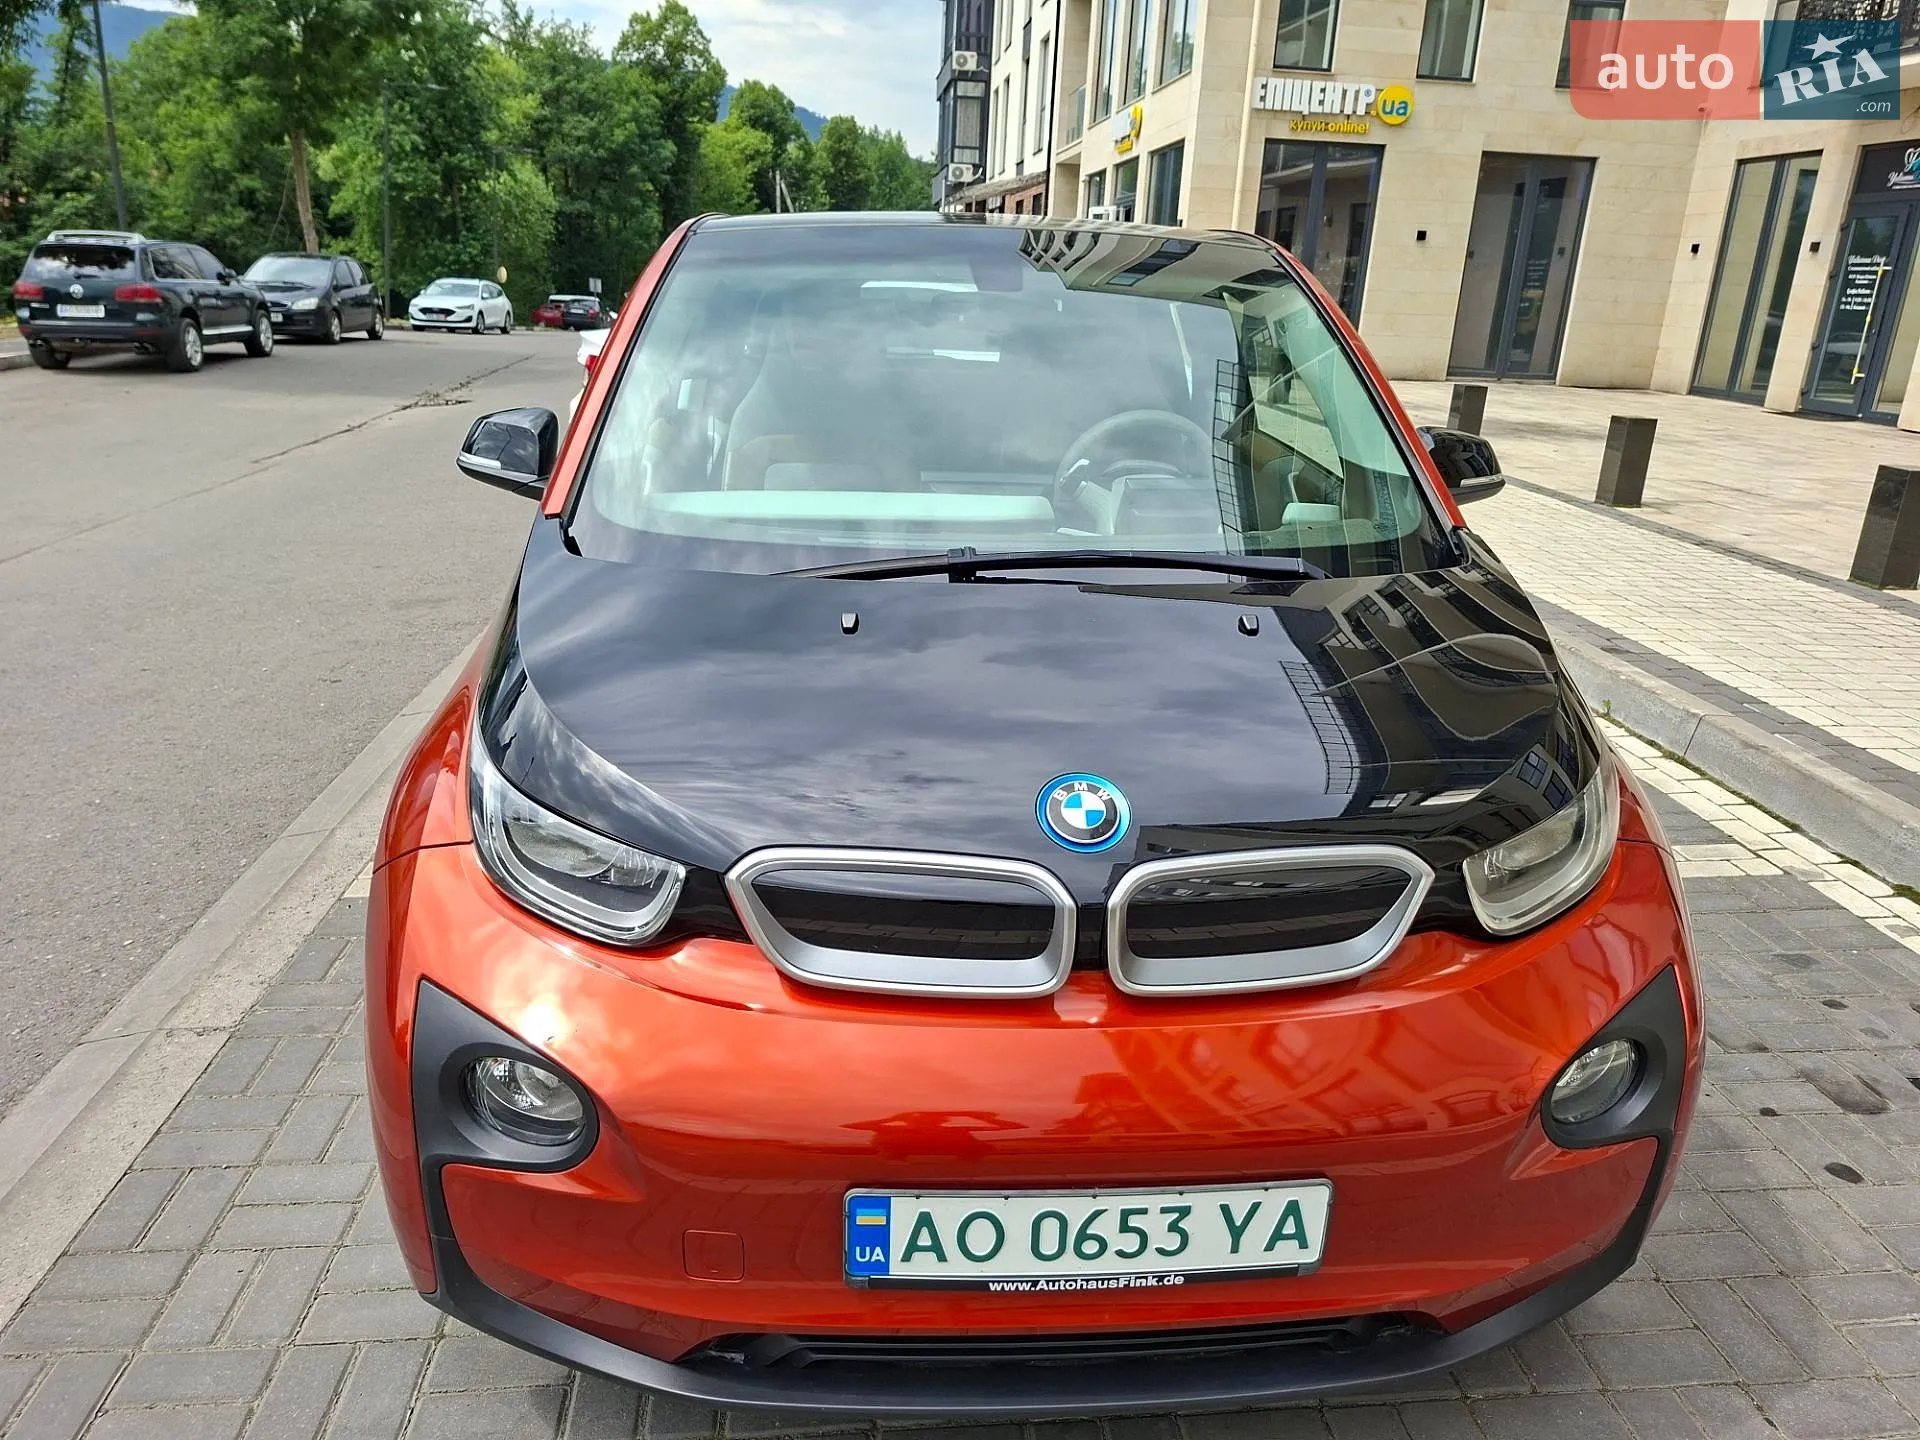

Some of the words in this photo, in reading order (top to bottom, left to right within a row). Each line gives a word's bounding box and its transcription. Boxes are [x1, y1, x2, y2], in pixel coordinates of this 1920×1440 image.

[1328, 120, 1370, 134] online!
[1053, 781, 1113, 801] BMW
[900, 1210, 1005, 1263] AO
[1030, 1205, 1192, 1262] 0653
[1219, 1199, 1309, 1254] YA
[855, 1246, 886, 1263] UA
[988, 1274, 1185, 1292] www.AutohausFink.de
